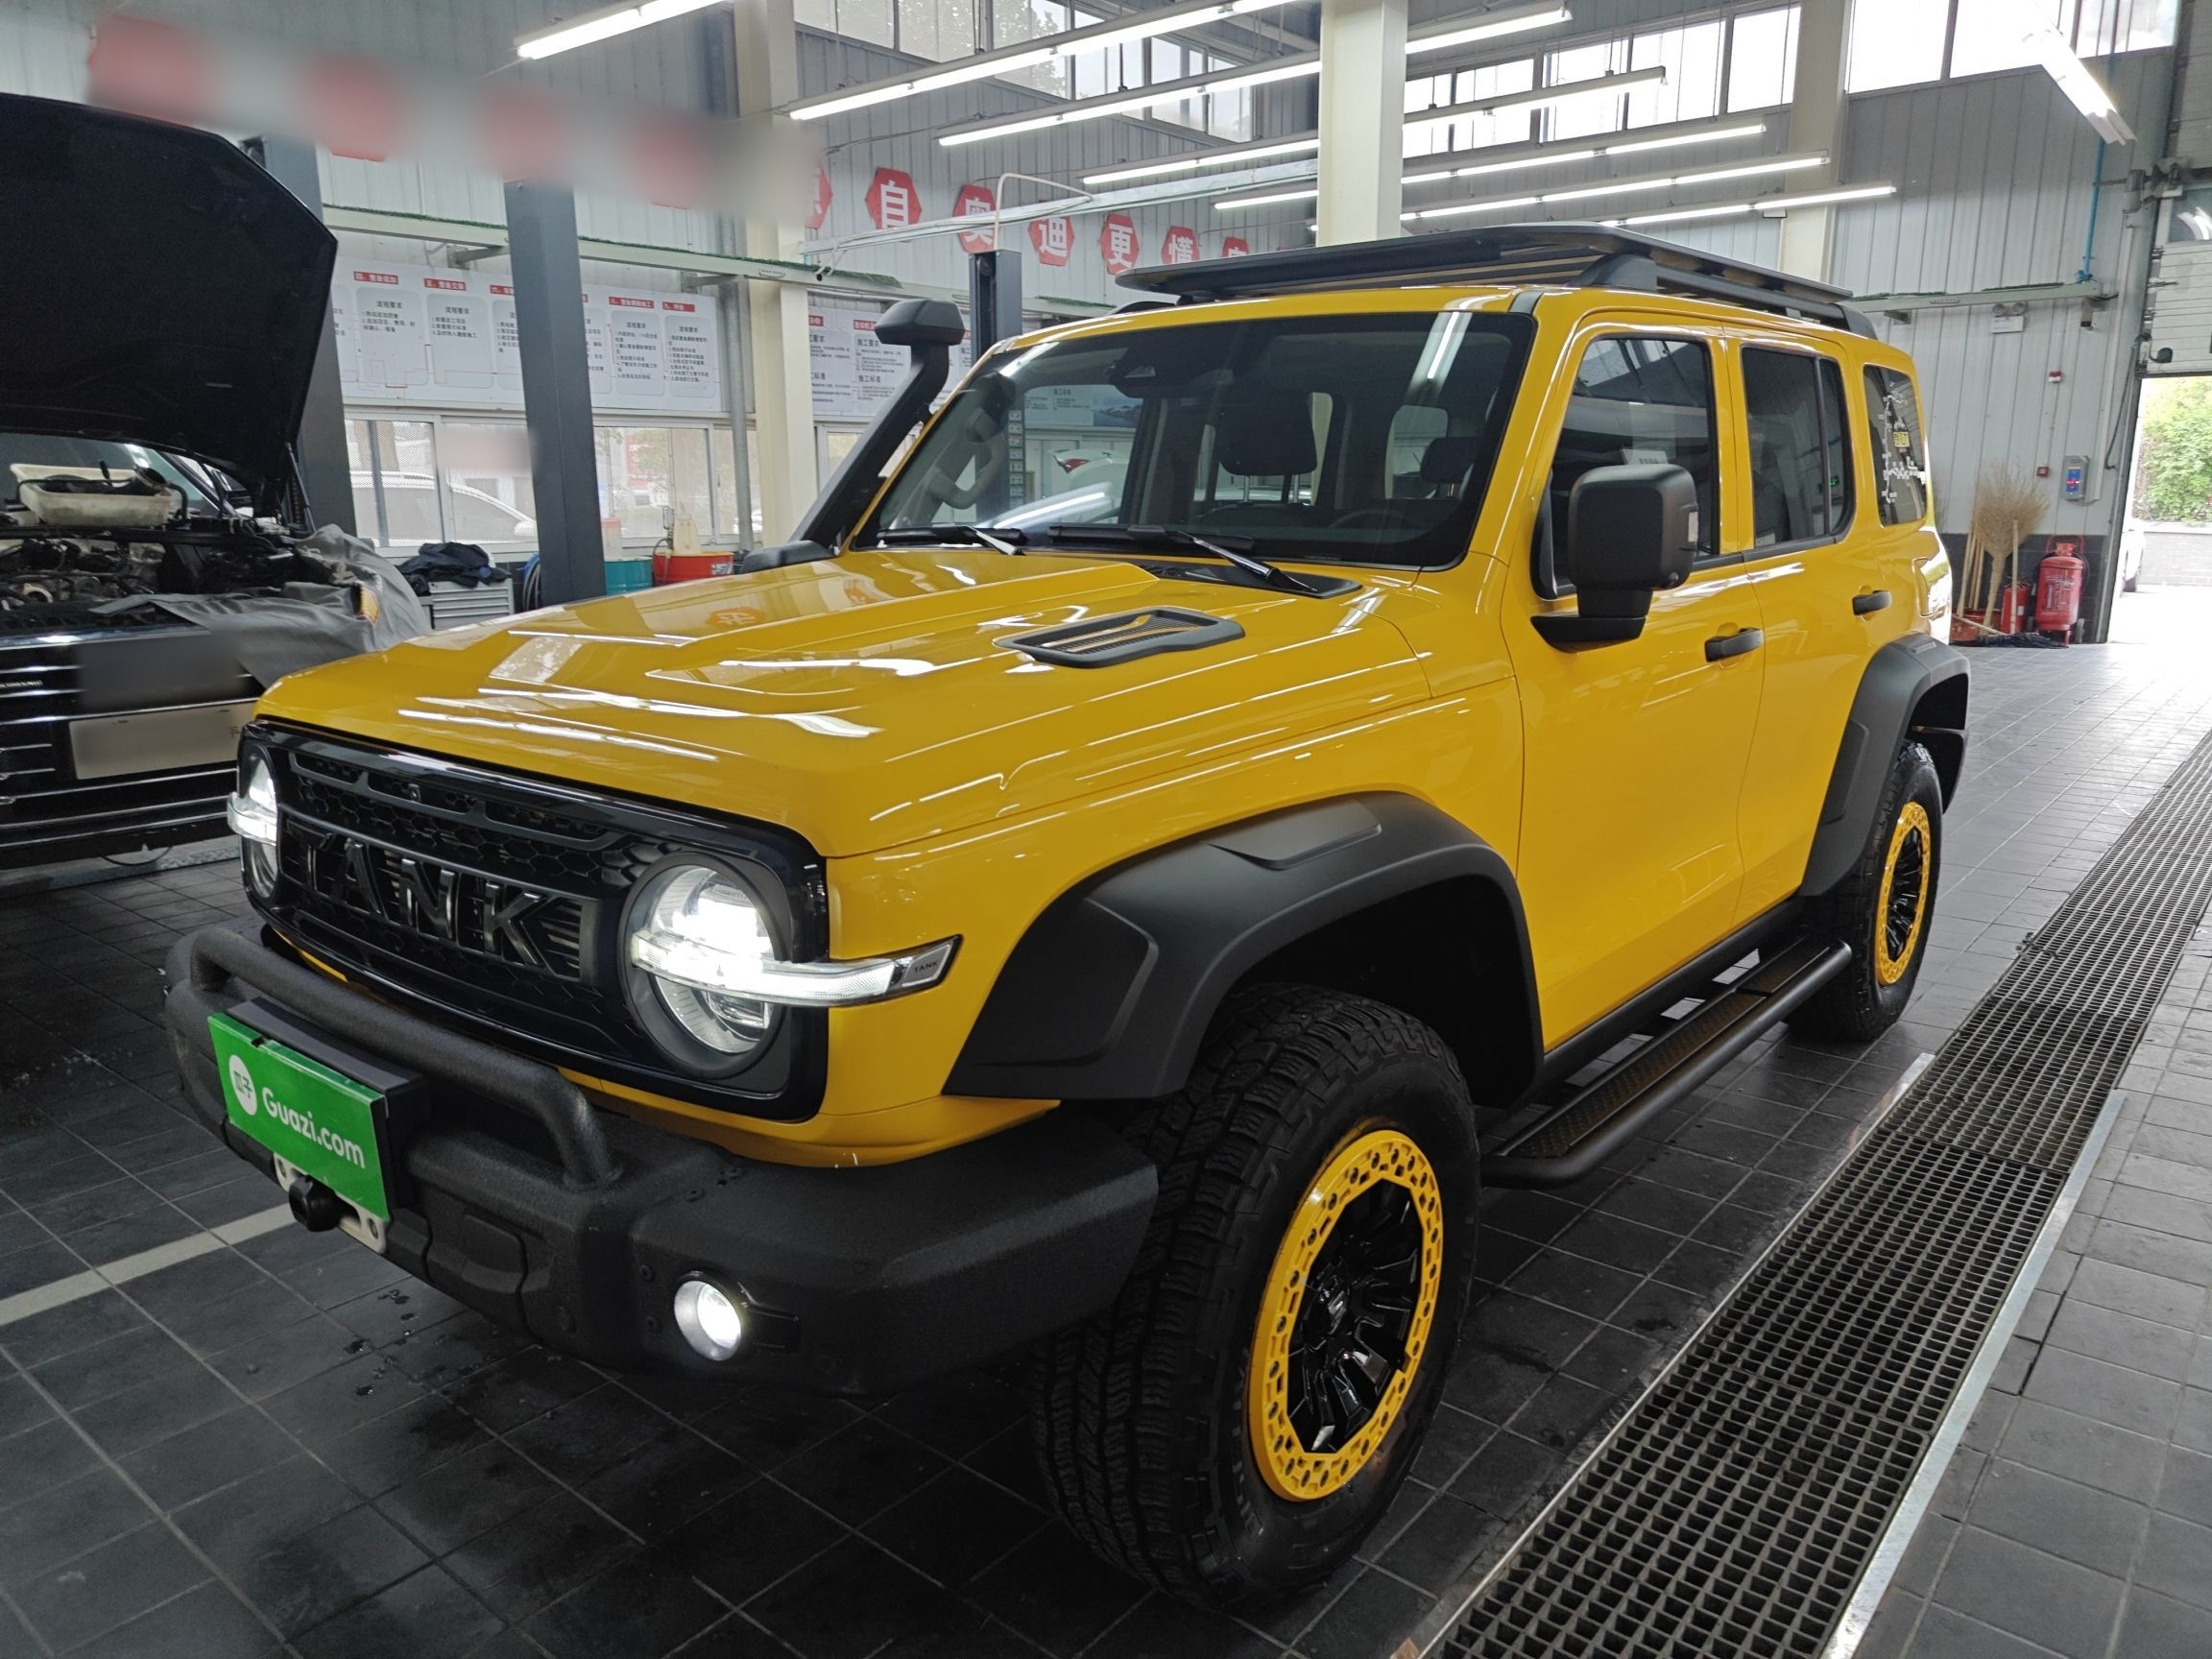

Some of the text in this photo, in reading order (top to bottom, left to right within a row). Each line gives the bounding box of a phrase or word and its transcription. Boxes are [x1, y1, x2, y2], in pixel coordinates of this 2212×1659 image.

[286, 820, 544, 966] TANK
[913, 960, 938, 974] TANK
[261, 1087, 366, 1169] Guazi.com
